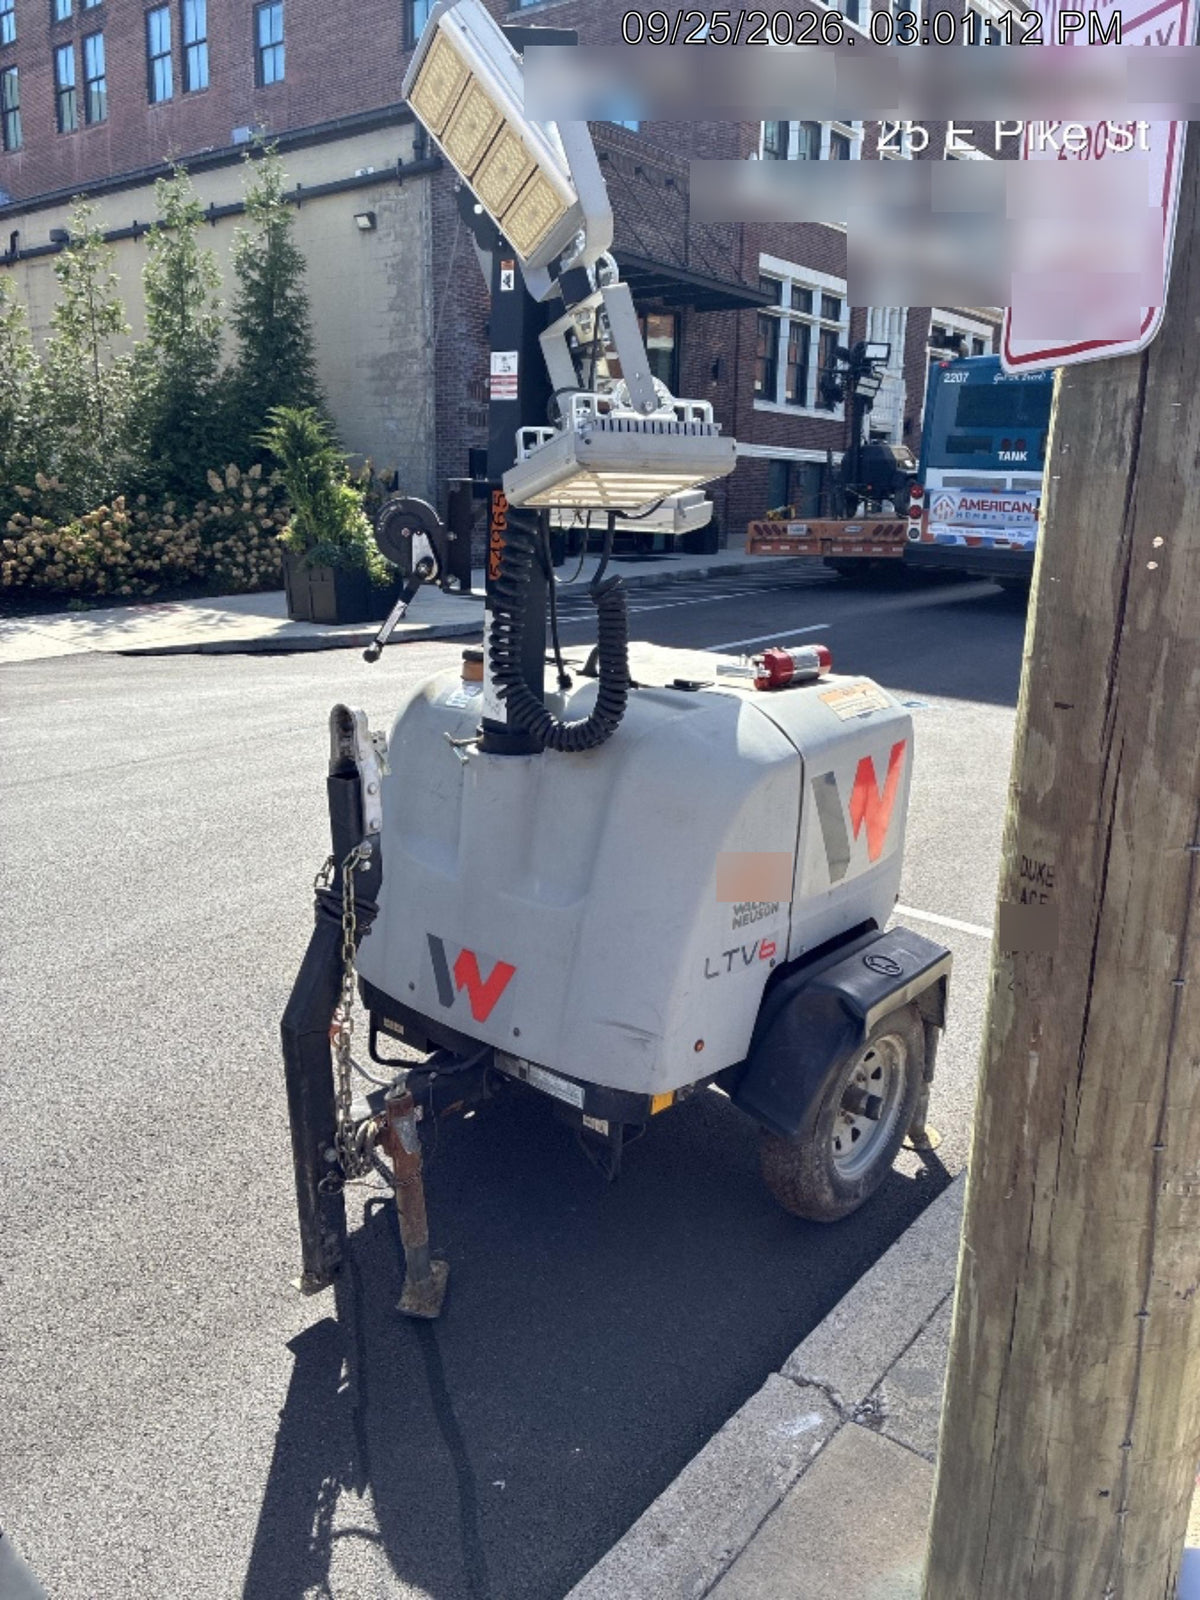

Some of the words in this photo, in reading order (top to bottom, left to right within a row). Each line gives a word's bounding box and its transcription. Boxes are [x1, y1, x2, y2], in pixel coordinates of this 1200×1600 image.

[943, 372, 970, 383] 2207
[997, 451, 1029, 461] TANK
[958, 498, 1033, 513] AMERICAN
[704, 938, 776, 979] LTV6
